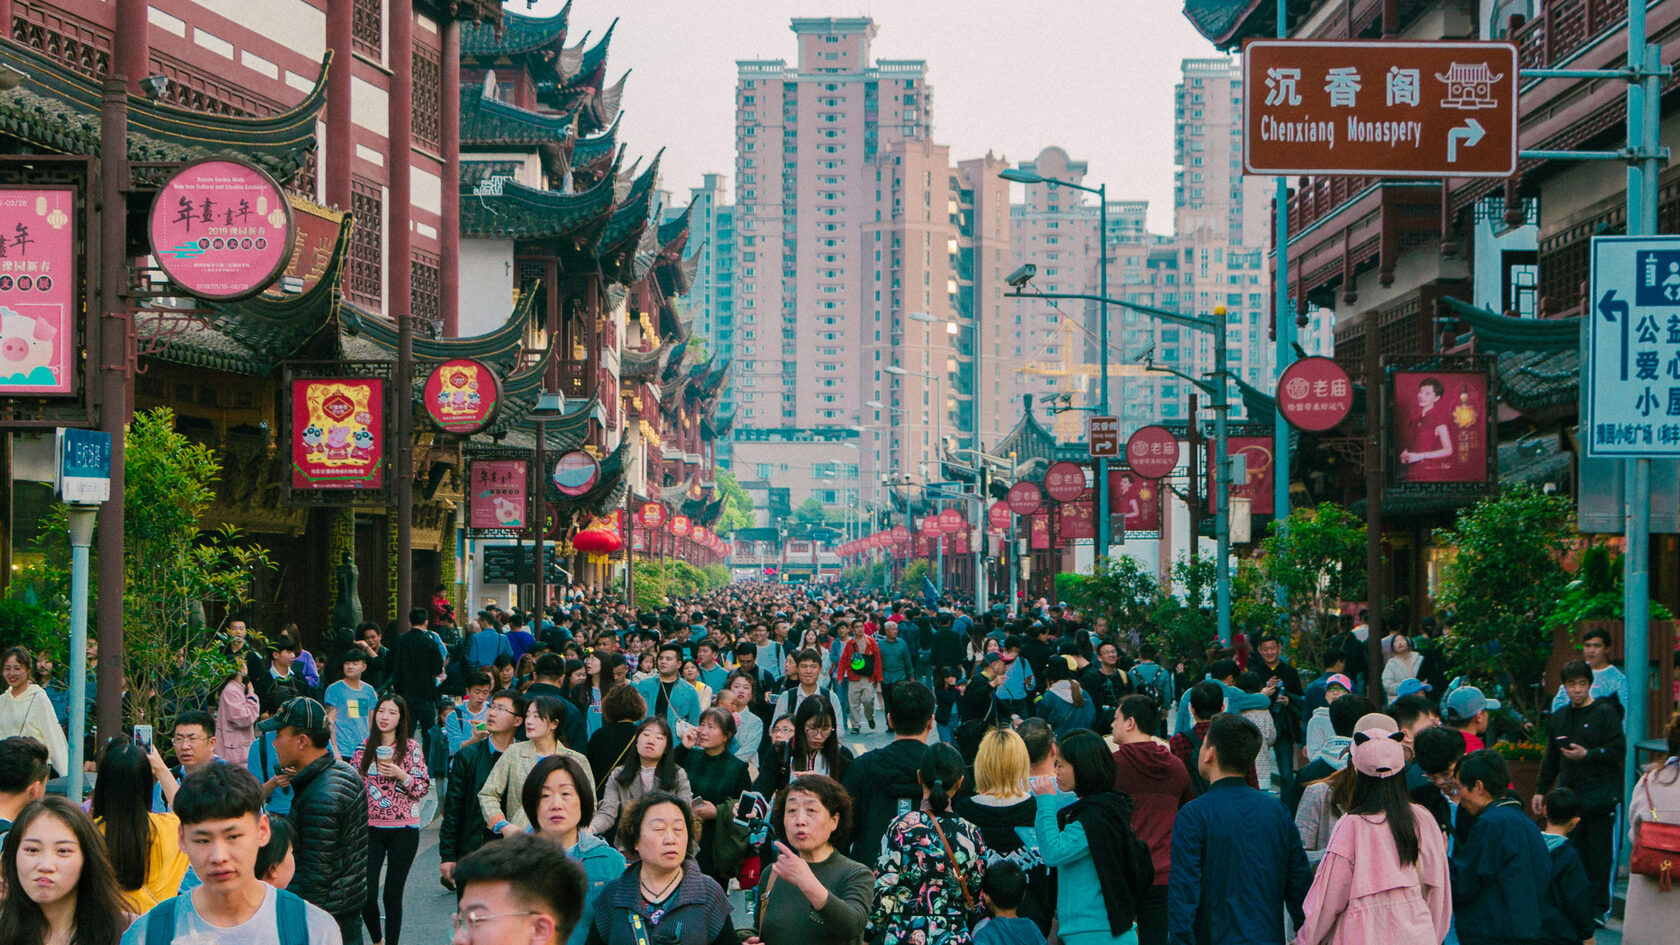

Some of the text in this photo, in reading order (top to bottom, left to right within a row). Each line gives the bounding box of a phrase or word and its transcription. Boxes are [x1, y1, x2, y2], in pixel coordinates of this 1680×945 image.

[1264, 65, 1420, 107] 沉香阁
[1261, 114, 1421, 149] Chenxiang Monaspery
[208, 226, 228, 236] 2019
[1313, 378, 1347, 397] 老庙
[1151, 442, 1175, 455] 老庙
